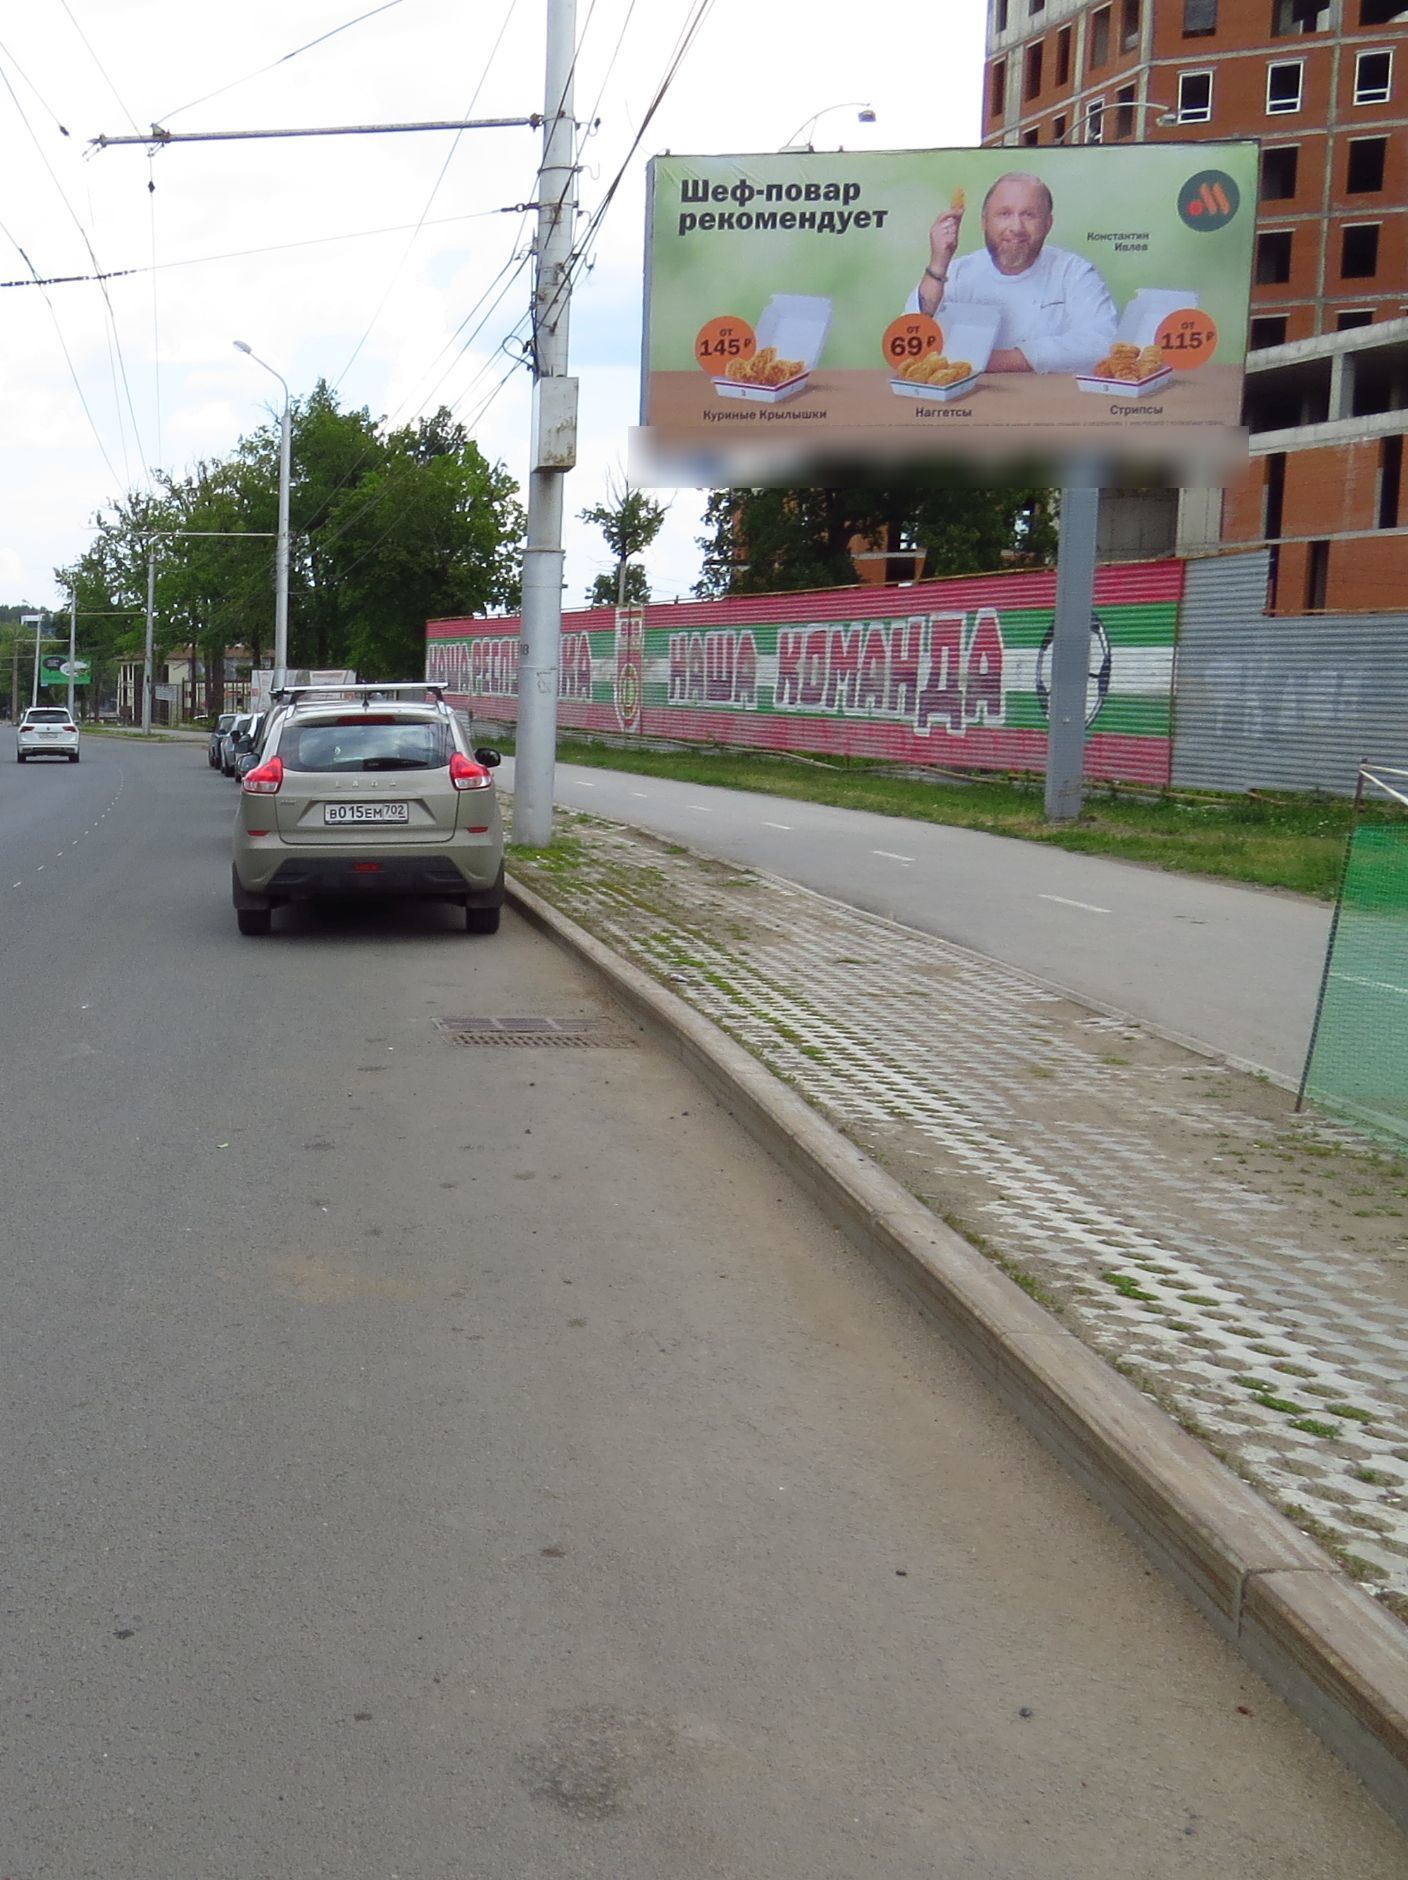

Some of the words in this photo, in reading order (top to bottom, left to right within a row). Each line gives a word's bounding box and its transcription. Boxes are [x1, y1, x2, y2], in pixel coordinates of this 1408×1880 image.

[680, 178, 861, 207] Шеф-повар
[678, 209, 888, 236] рекомендует
[1086, 232, 1150, 241] Константин
[703, 410, 757, 422] Куриные
[759, 410, 827, 421] Крылышки
[915, 407, 972, 418] Наггетсы
[1110, 404, 1163, 416] Стрипсы
[773, 608, 1006, 737] КОМАНДА
